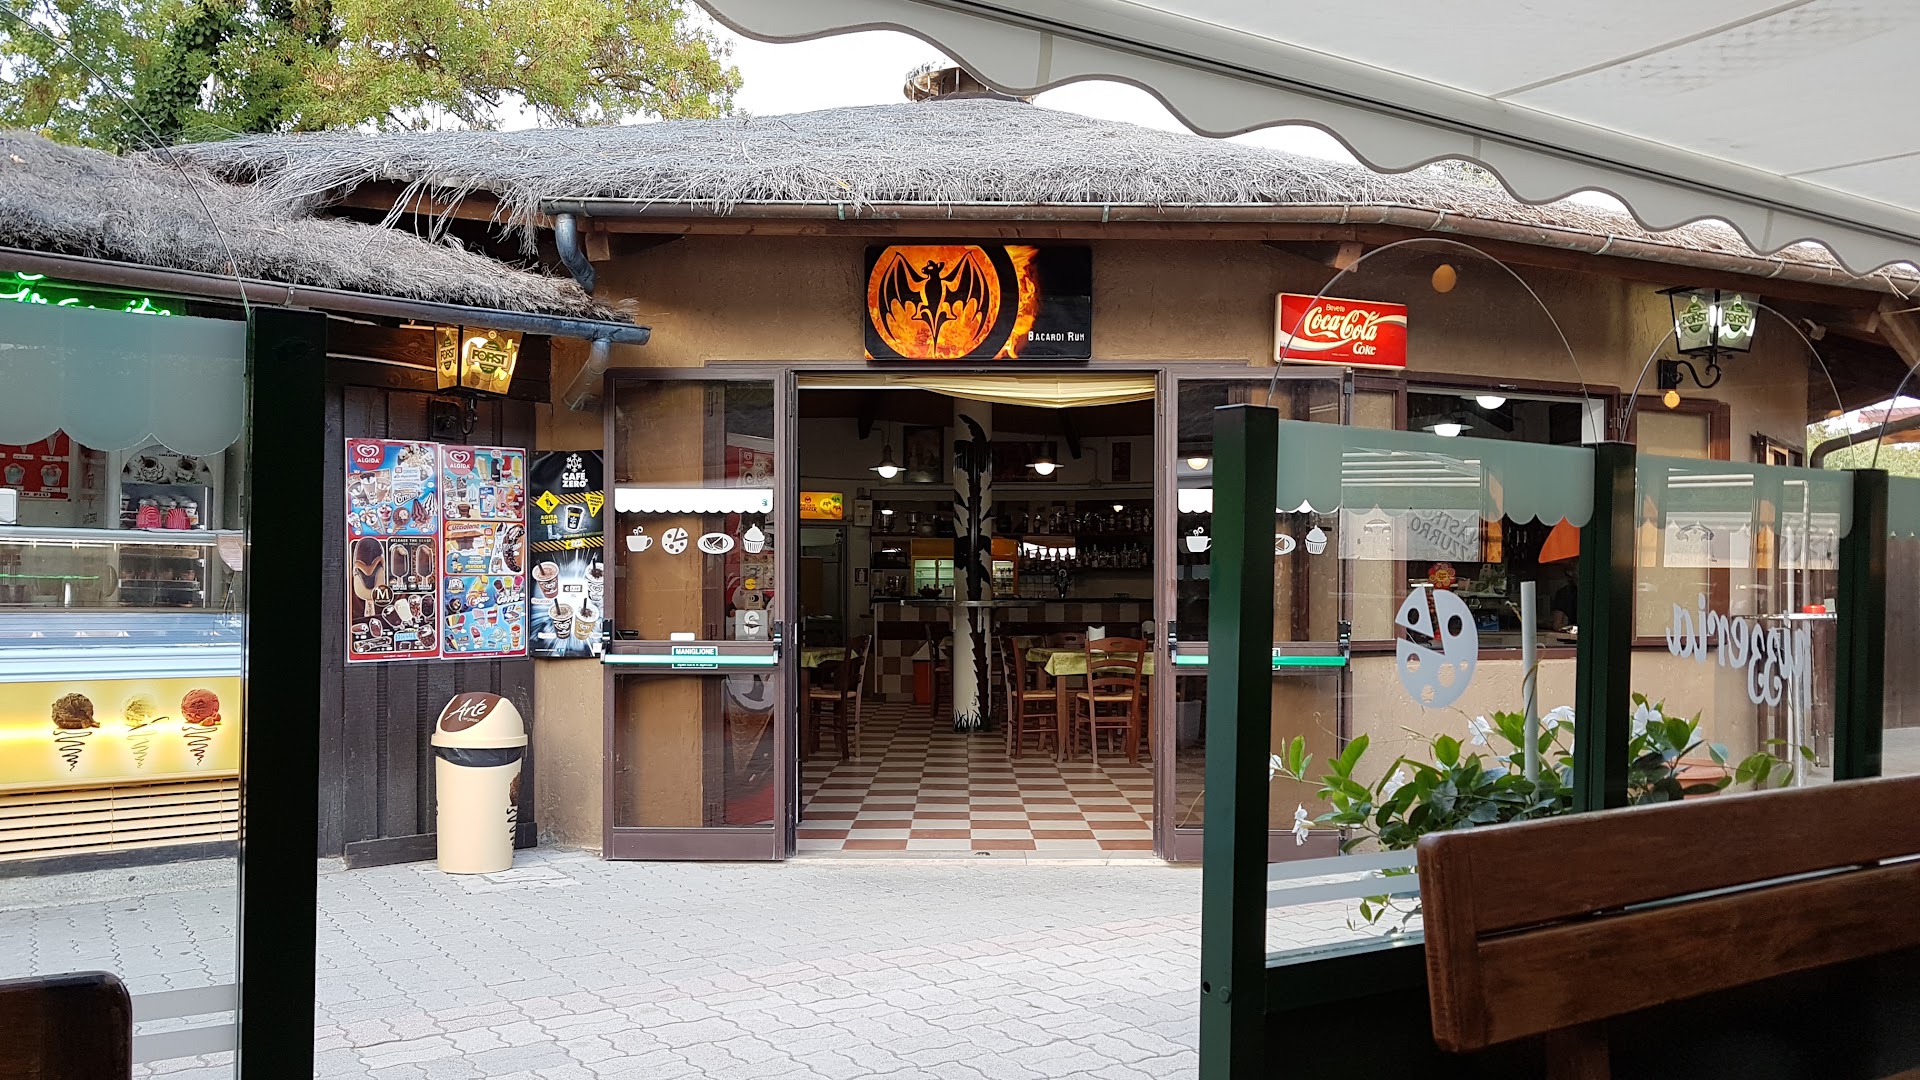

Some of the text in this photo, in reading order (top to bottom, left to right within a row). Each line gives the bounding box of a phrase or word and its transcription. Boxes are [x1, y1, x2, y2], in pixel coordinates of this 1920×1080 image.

[1682, 313, 1708, 325] FORST
[1725, 312, 1749, 324] FORST
[440, 347, 455, 360] FORST
[1352, 342, 1376, 356] Coke
[472, 349, 507, 364] FORST
[562, 470, 585, 480] CAFÉ
[376, 588, 389, 600] M
[444, 698, 487, 721] Arte
